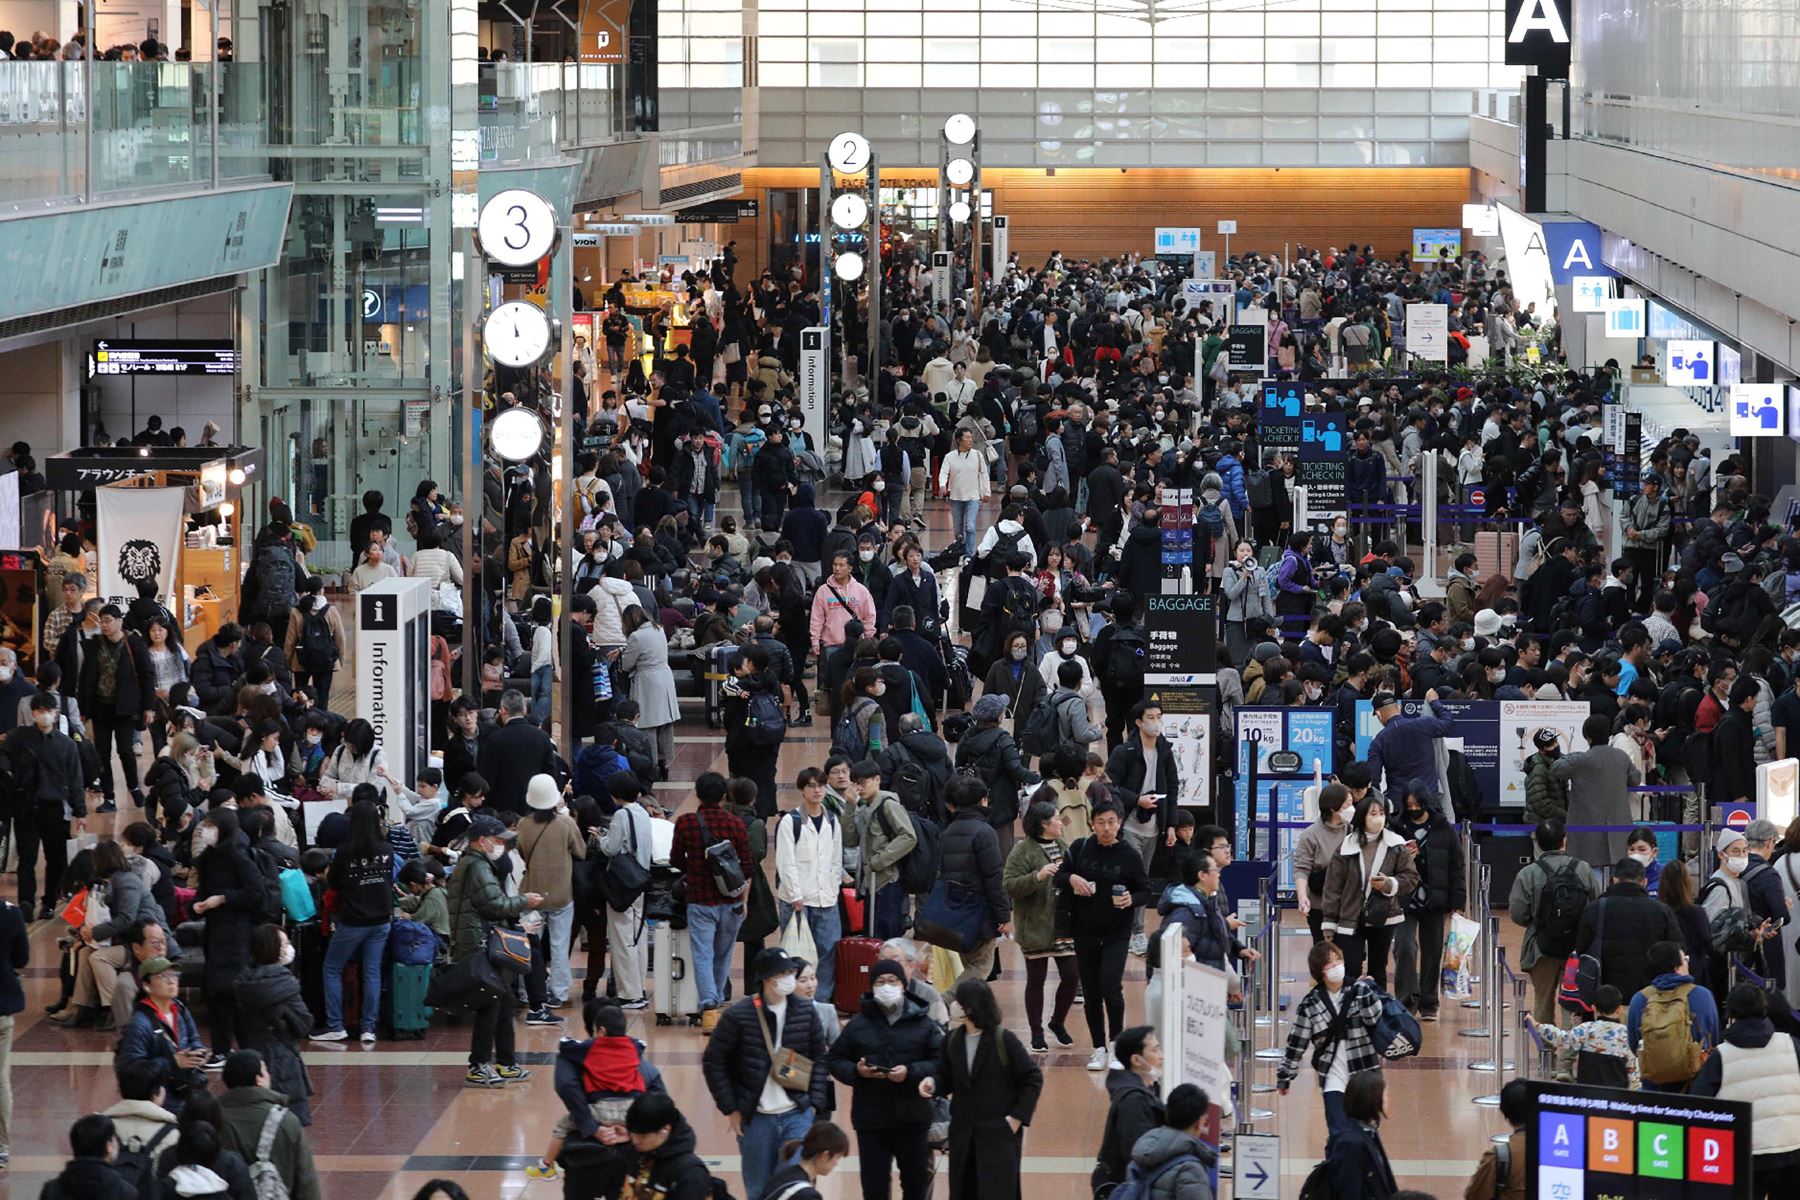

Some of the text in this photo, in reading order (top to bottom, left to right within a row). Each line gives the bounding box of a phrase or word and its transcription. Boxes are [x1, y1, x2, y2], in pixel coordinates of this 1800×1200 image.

[1508, 0, 1569, 42] A
[843, 141, 857, 165] 2
[842, 179, 937, 188] EXCE OTEL TOKYU
[504, 205, 531, 250] 3
[1524, 232, 1546, 256] A
[1563, 239, 1593, 270] A
[1231, 327, 1263, 335] BAGGAGE
[808, 355, 817, 410] Information
[1302, 462, 1344, 471] TICKETING
[1335, 471, 1344, 480] IN
[1150, 598, 1211, 611] BAGGAGE
[1150, 631, 1177, 640] 手荷物
[1149, 643, 1178, 651] Baggage
[1169, 675, 1186, 683] ANA
[1243, 728, 1274, 744] 10 kg
[1292, 728, 1325, 744] 20 kg
[1239, 782, 1248, 859] ENTRANCE
[1385, 1043, 1414, 1057] adidas
[1638, 1104, 1654, 1113] time
[1654, 1105, 1665, 1115] for
[1665, 1107, 1693, 1119] Security
[1554, 1124, 1569, 1146] A
[1603, 1128, 1618, 1150] B
[1653, 1133, 1668, 1155] C
[1704, 1138, 1719, 1161] D
[1553, 1149, 1569, 1157] GATE
[1603, 1154, 1619, 1162] GATE
[1653, 1160, 1669, 1168] GATE
[1703, 1165, 1719, 1173] GATE
